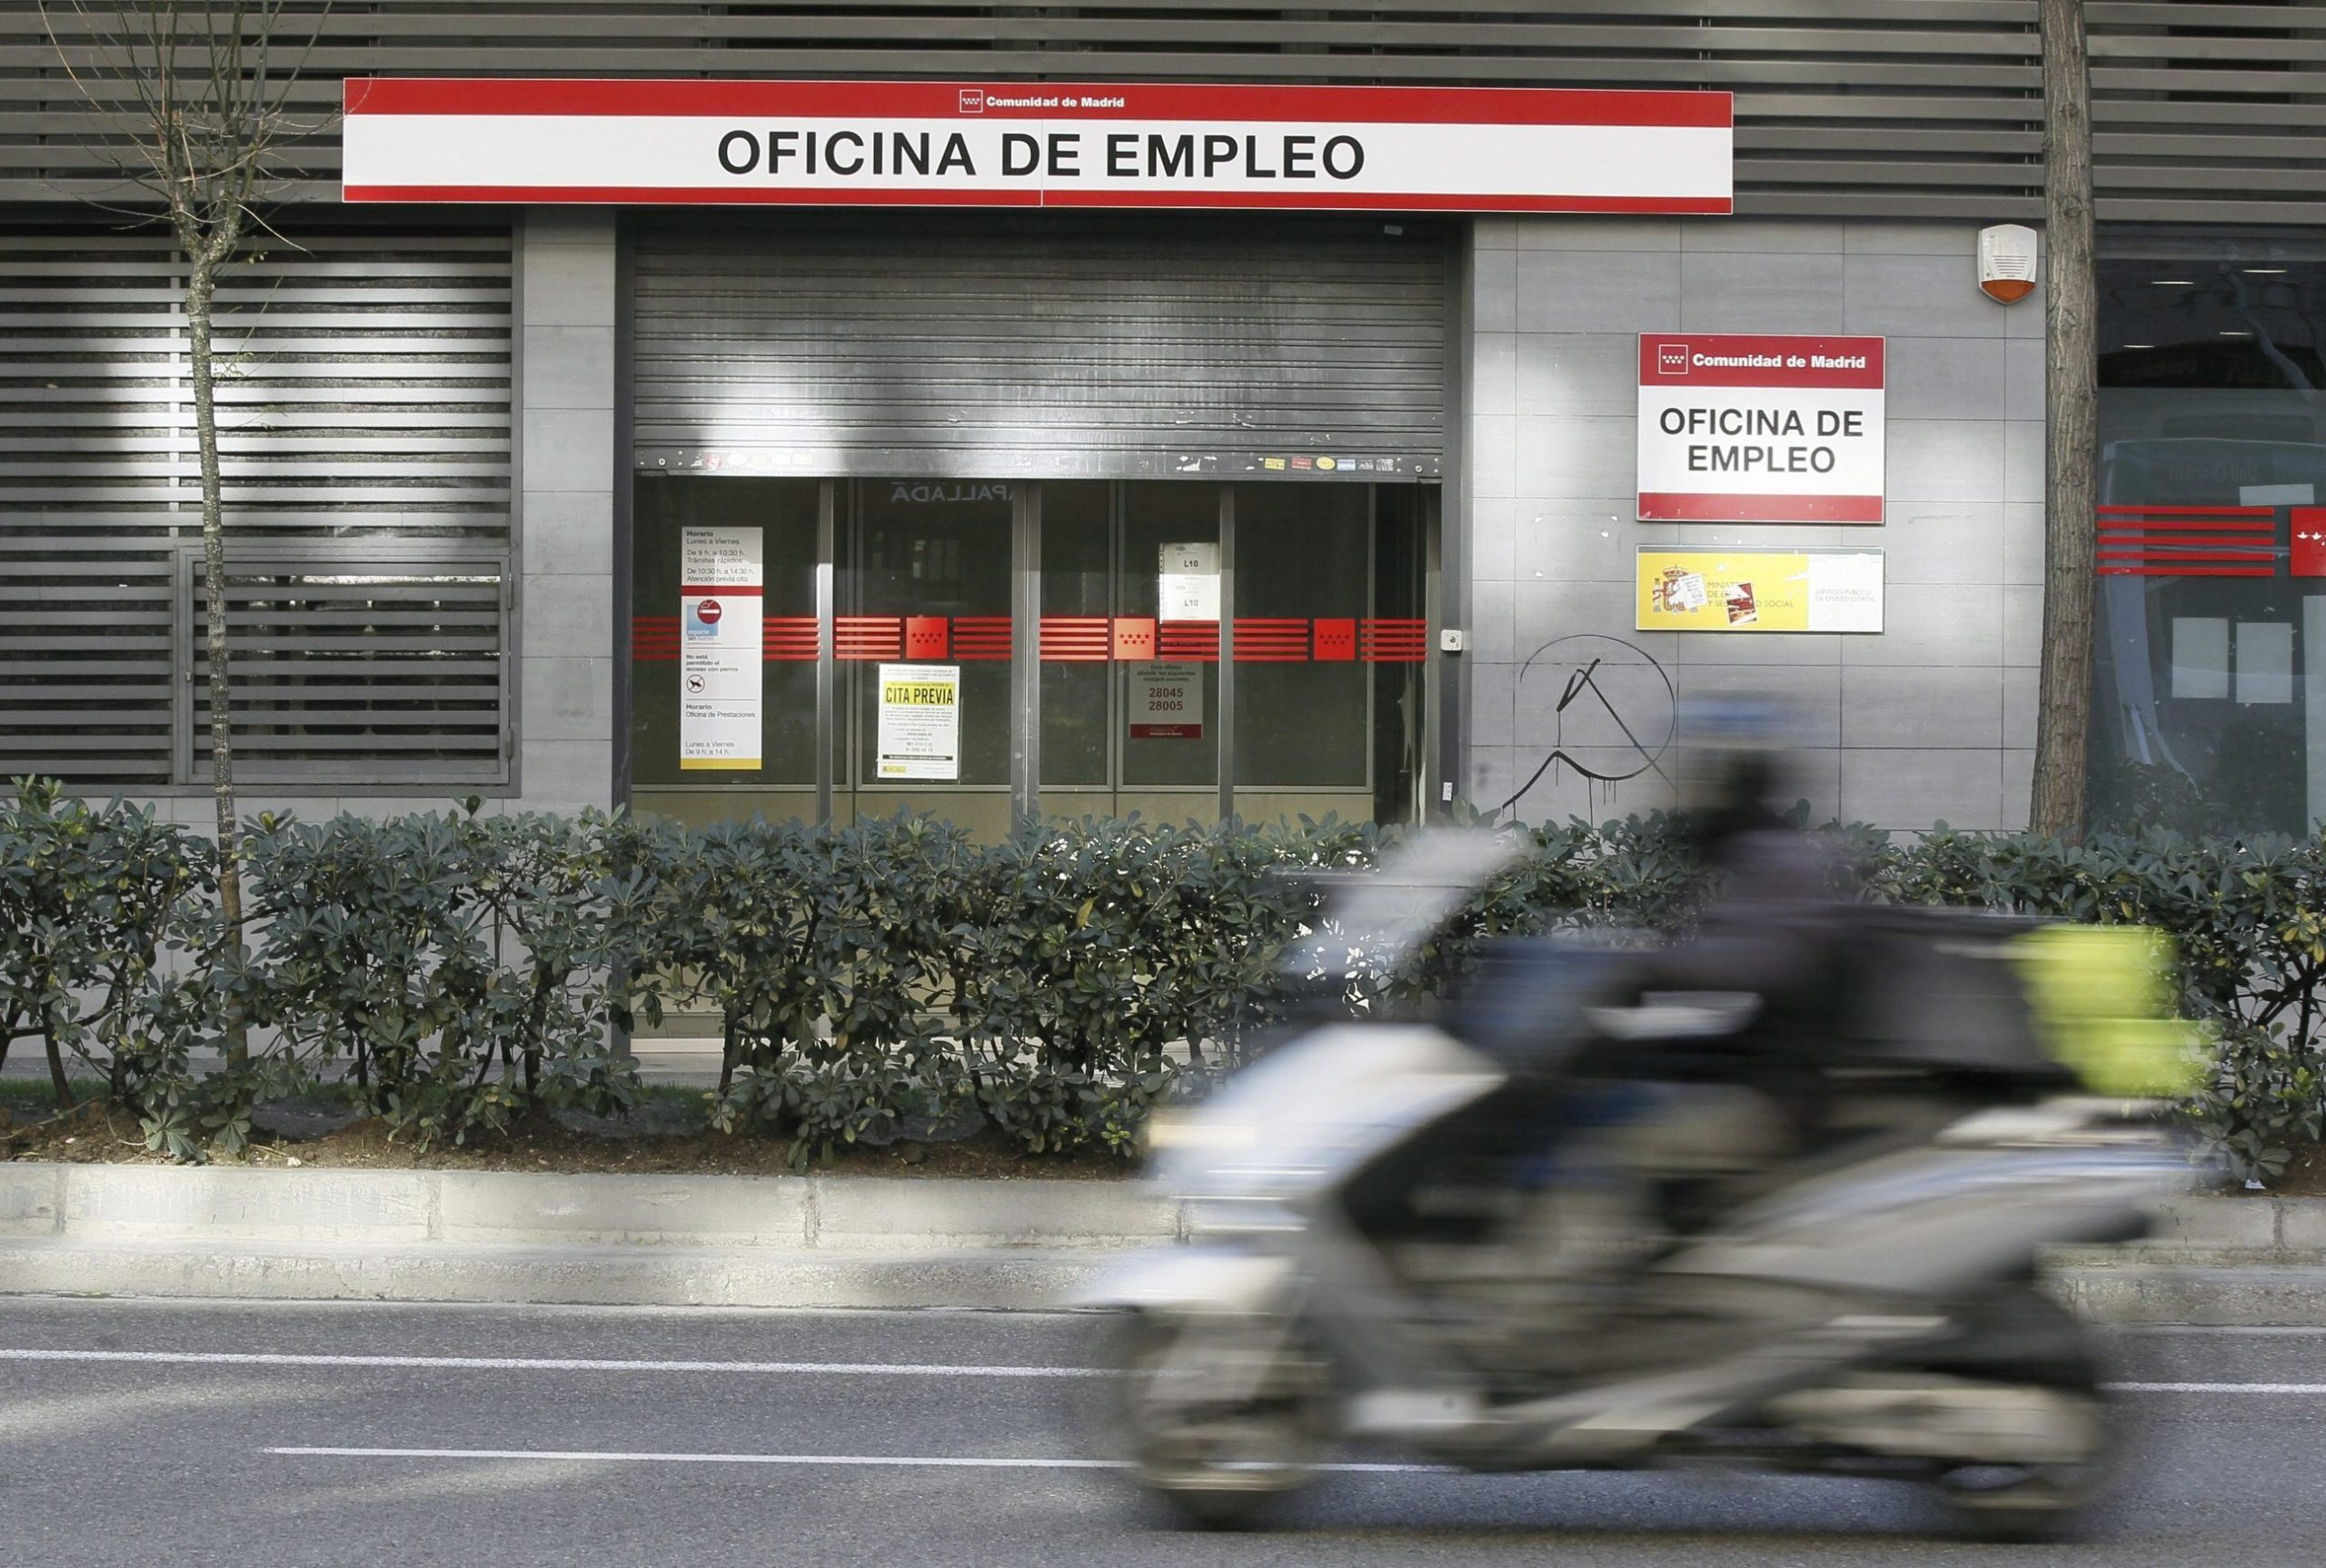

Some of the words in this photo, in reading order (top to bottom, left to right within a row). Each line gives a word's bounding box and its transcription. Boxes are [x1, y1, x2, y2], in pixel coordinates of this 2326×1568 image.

[986, 96, 1059, 108] Comunidad
[1061, 96, 1078, 108] de
[1080, 97, 1125, 108] Madrid
[718, 130, 977, 175] OFICINA
[1001, 133, 1080, 176] DE
[1107, 134, 1365, 180] EMPLEO
[1692, 353, 1782, 368] Comunidad
[1785, 355, 1806, 368] de
[1810, 355, 1866, 369] Madrid
[1659, 408, 1804, 436] OFICINA
[1817, 411, 1864, 437] DE
[1688, 445, 1835, 473] EMPLEO
[1184, 560, 1198, 568] L10
[1184, 599, 1198, 607] L10
[886, 687, 910, 703] CITA
[913, 688, 954, 704] PREVIA
[1148, 688, 1183, 698] 28045
[1148, 701, 1183, 710] 28005
